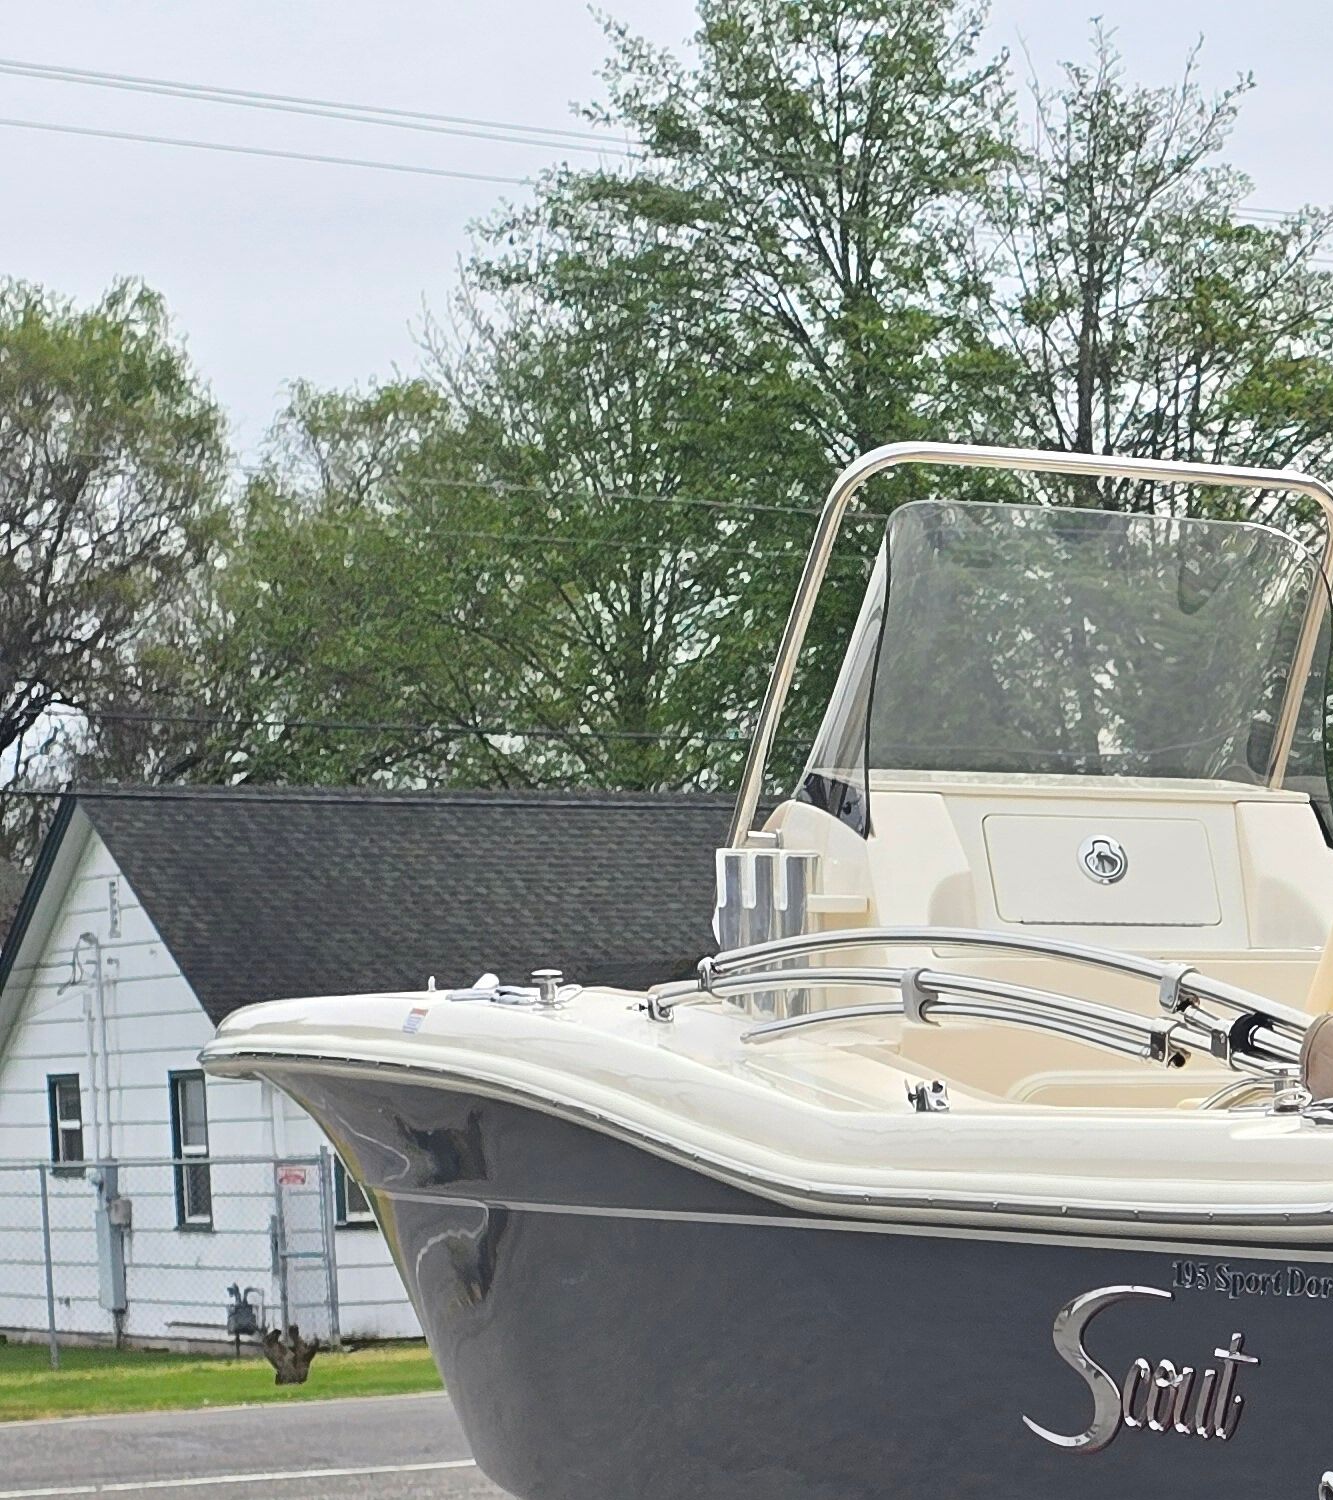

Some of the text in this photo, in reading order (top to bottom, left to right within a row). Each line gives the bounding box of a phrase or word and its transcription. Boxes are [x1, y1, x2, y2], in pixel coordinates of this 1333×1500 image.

[1172, 1260, 1210, 1290] 195
[1214, 1263, 1282, 1299] Sport
[1022, 1285, 1260, 1453] Scout
